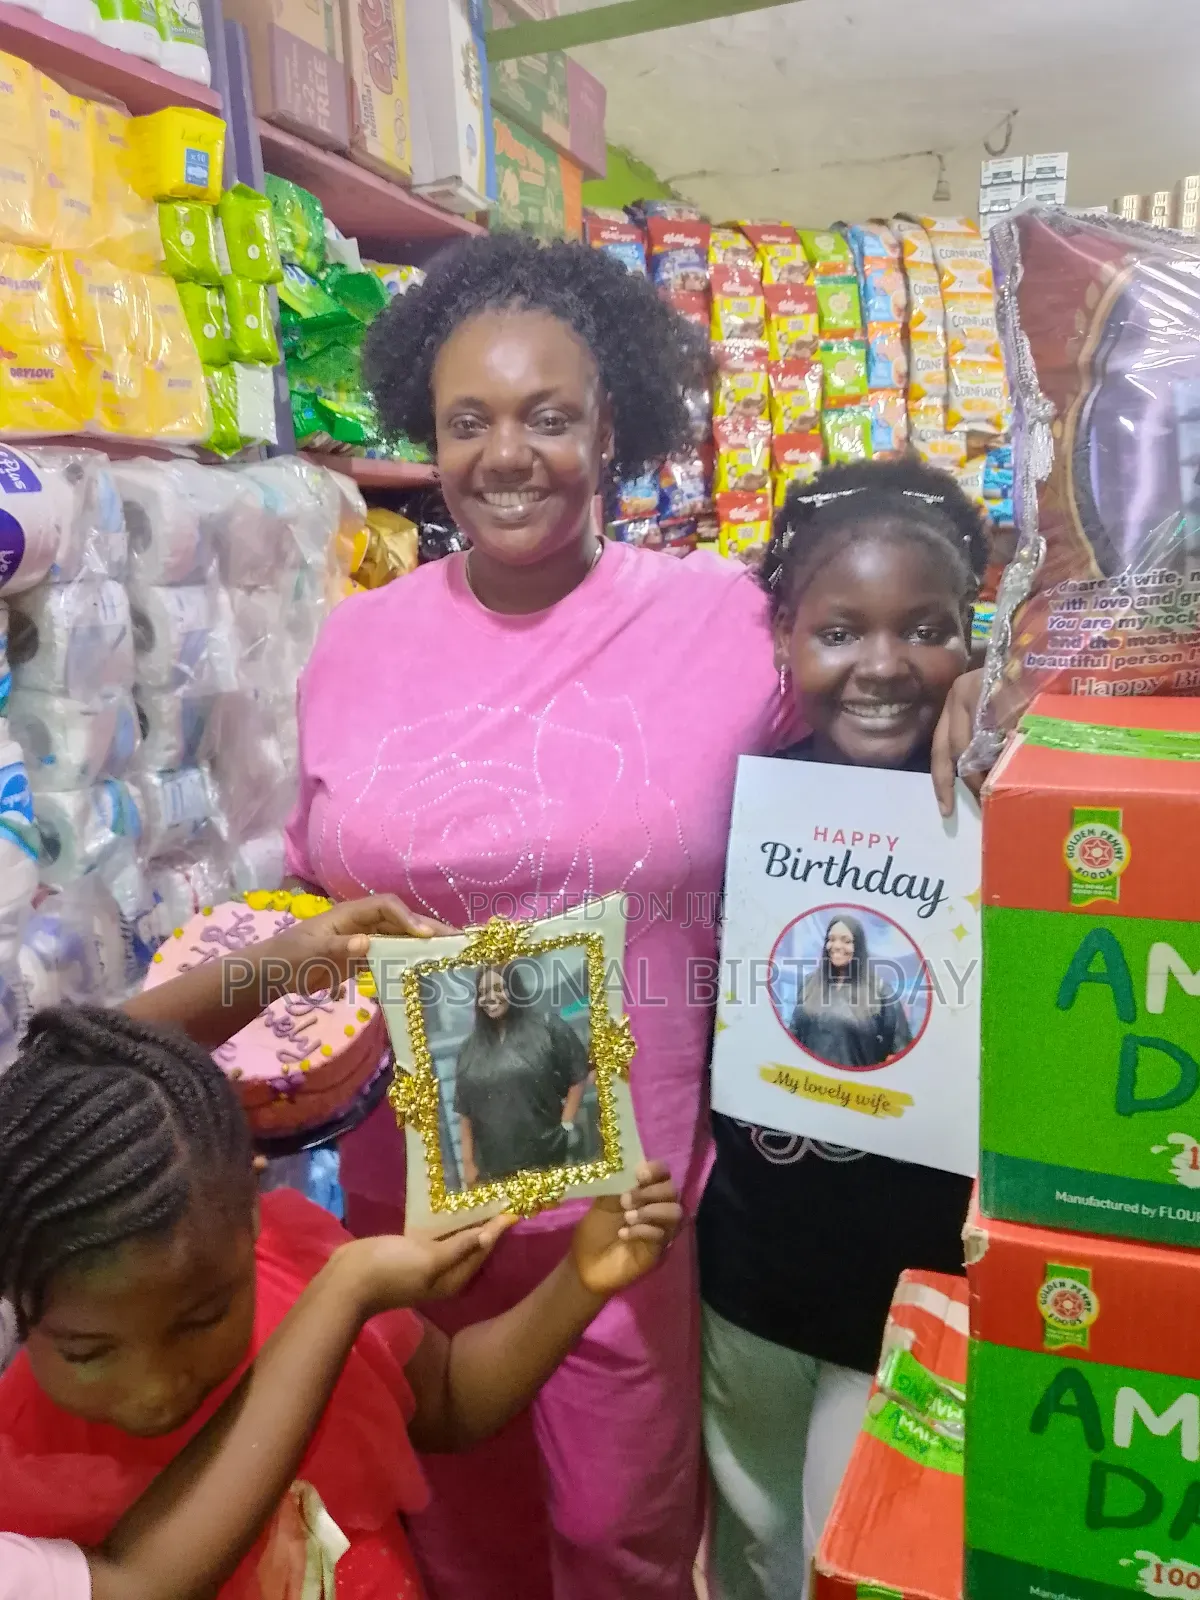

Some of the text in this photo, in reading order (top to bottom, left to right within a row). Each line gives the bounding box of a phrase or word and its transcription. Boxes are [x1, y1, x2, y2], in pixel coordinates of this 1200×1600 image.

[313, 56, 332, 133] FREE
[1093, 596, 1131, 609] love
[1136, 591, 1174, 607] and
[1048, 616, 1076, 630] You
[1081, 618, 1113, 630] are
[1118, 617, 1148, 631] my
[1025, 654, 1109, 668] beautiful
[1114, 653, 1183, 670] person
[1072, 675, 1167, 696] Happy
[812, 825, 899, 852] HAPPY
[760, 841, 950, 919] Birthday
[772, 1071, 892, 1116] My lovely wife
[1055, 1190, 1140, 1214] Manufactured
[1141, 1204, 1157, 1219] by
